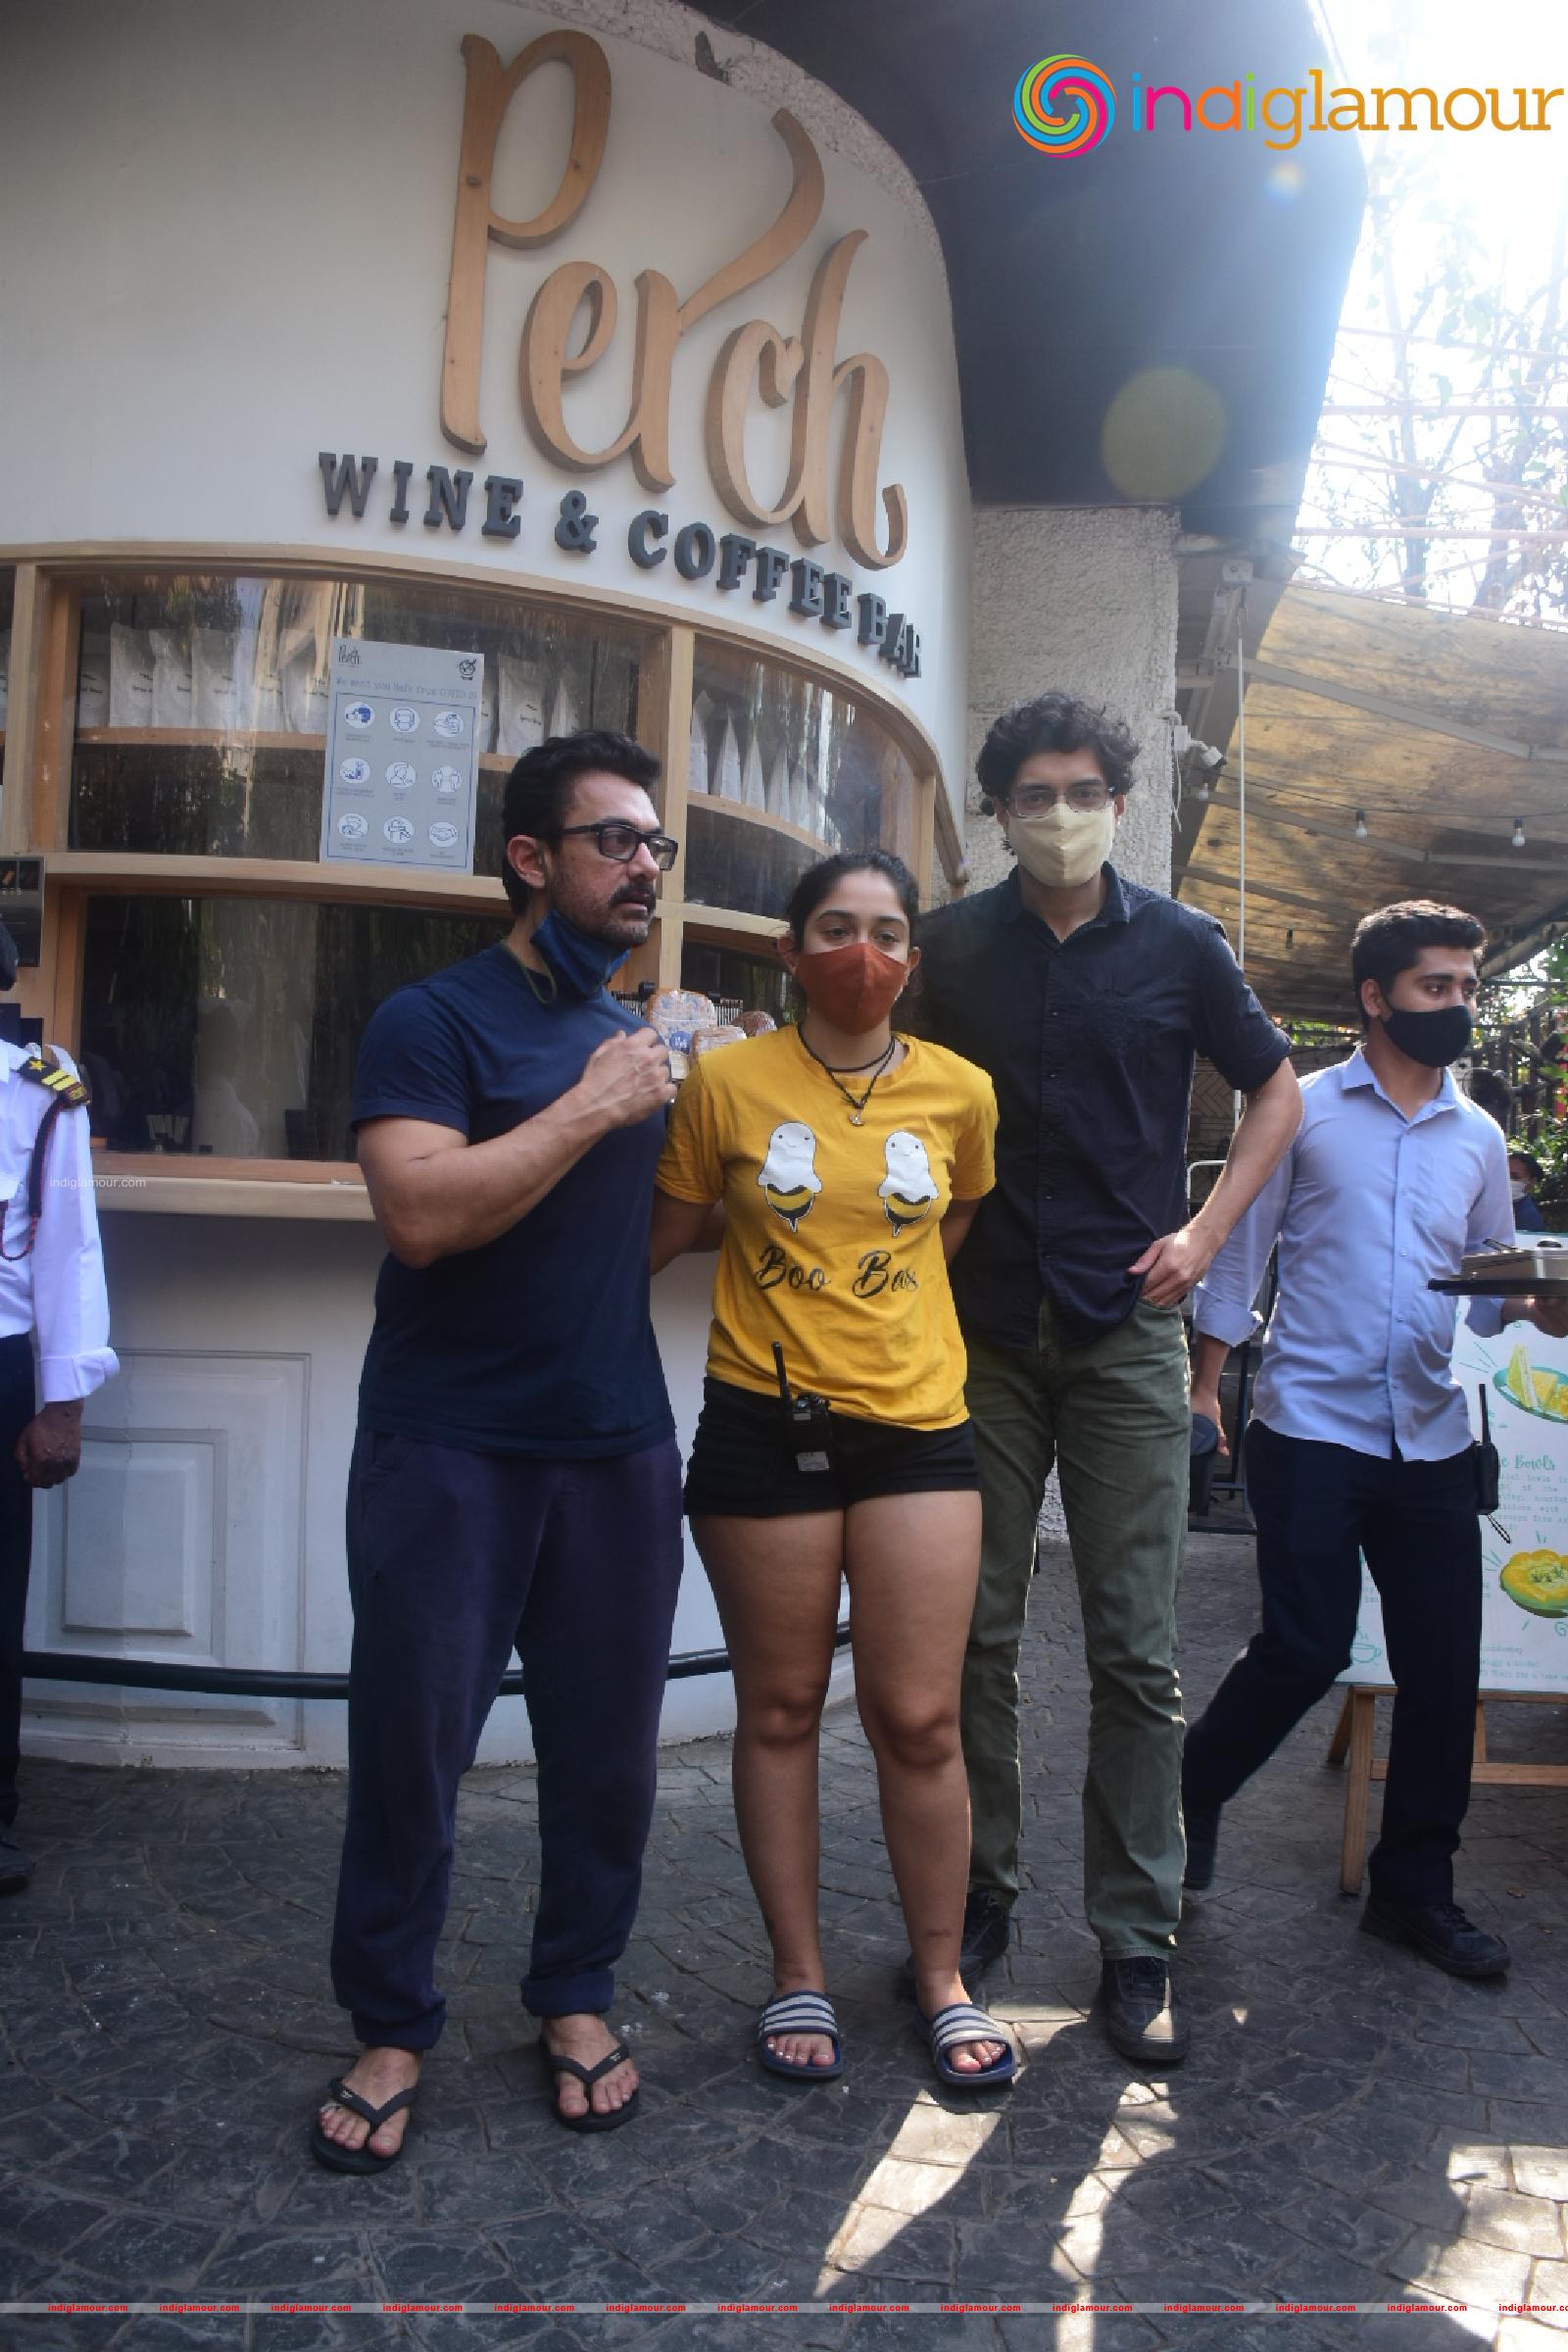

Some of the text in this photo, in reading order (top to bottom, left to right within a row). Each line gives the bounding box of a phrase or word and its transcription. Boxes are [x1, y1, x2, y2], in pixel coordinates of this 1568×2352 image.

[439, 28, 907, 570] Perch
[318, 451, 922, 679] WINE & COFFEE BAR
[755, 1244, 832, 1290] Boo
